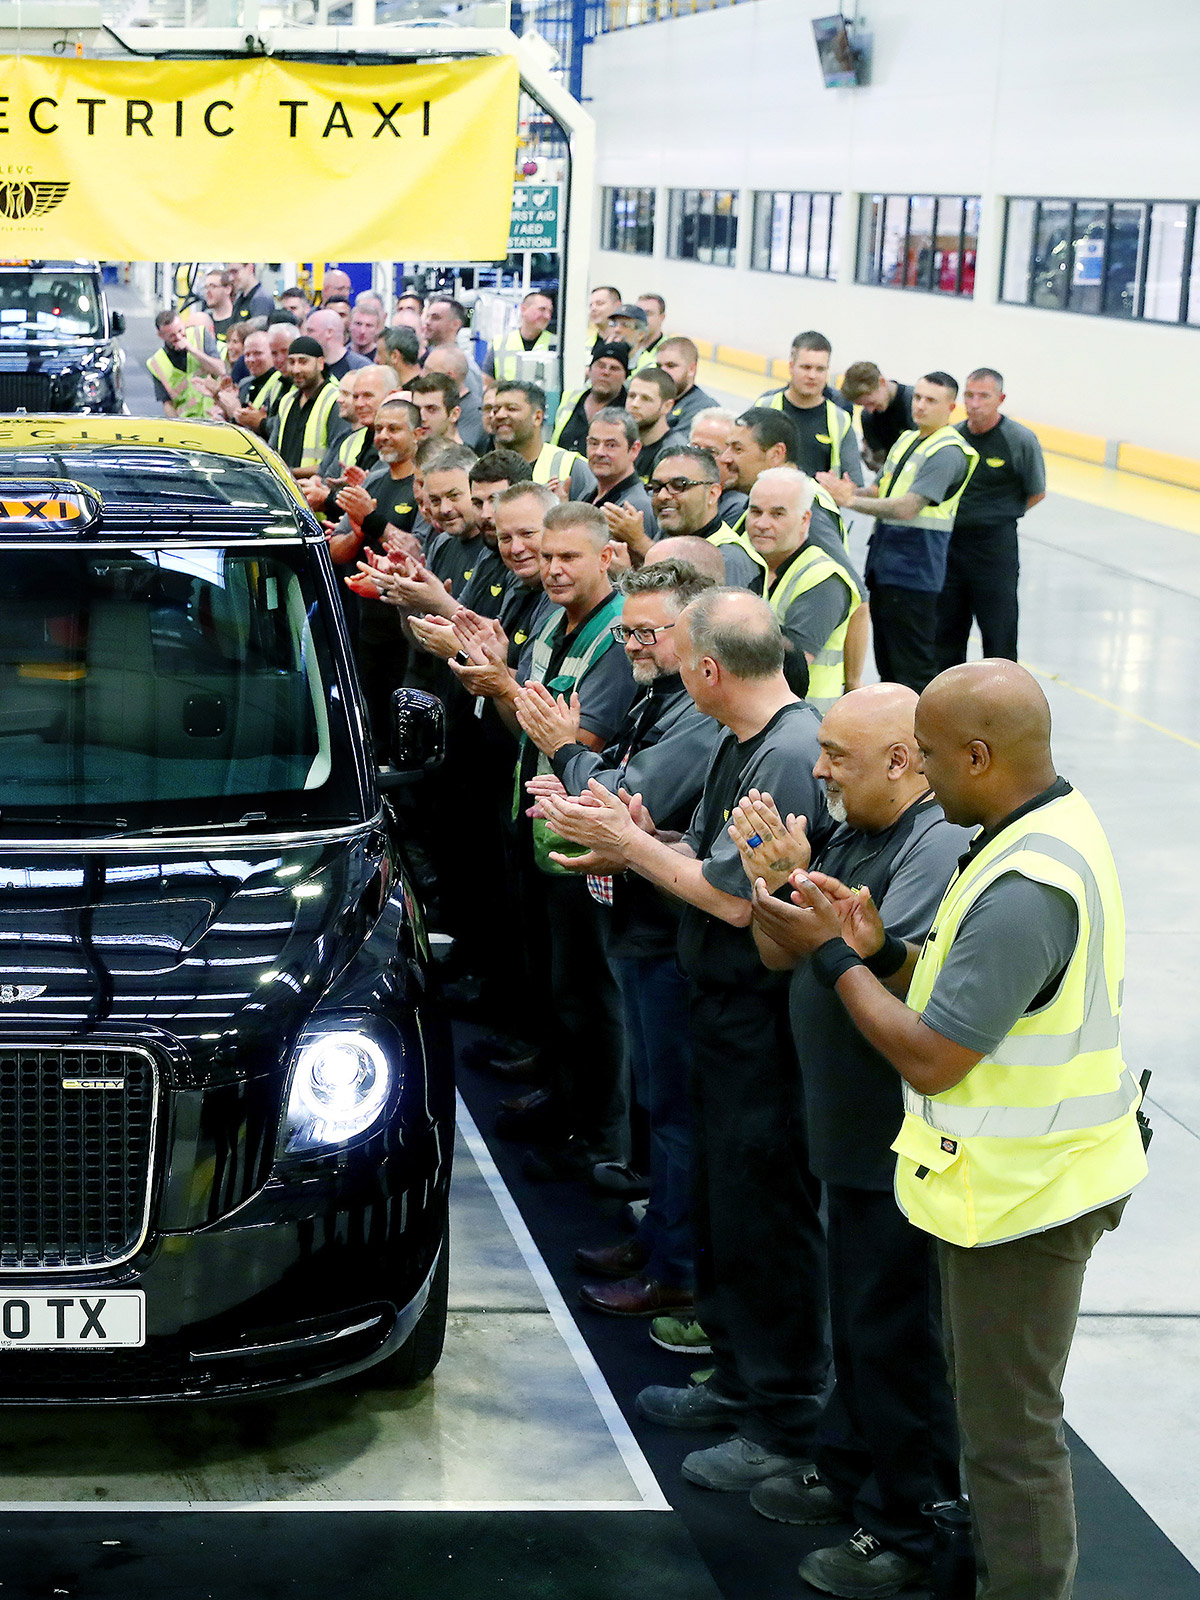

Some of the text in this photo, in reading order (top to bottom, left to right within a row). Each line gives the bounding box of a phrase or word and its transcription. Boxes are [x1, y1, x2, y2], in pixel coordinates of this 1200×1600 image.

[279, 100, 431, 138] TAXI
[510, 210, 556, 221] IRST AID
[507, 236, 552, 248] STATION
[46, 1299, 108, 1339] TX
